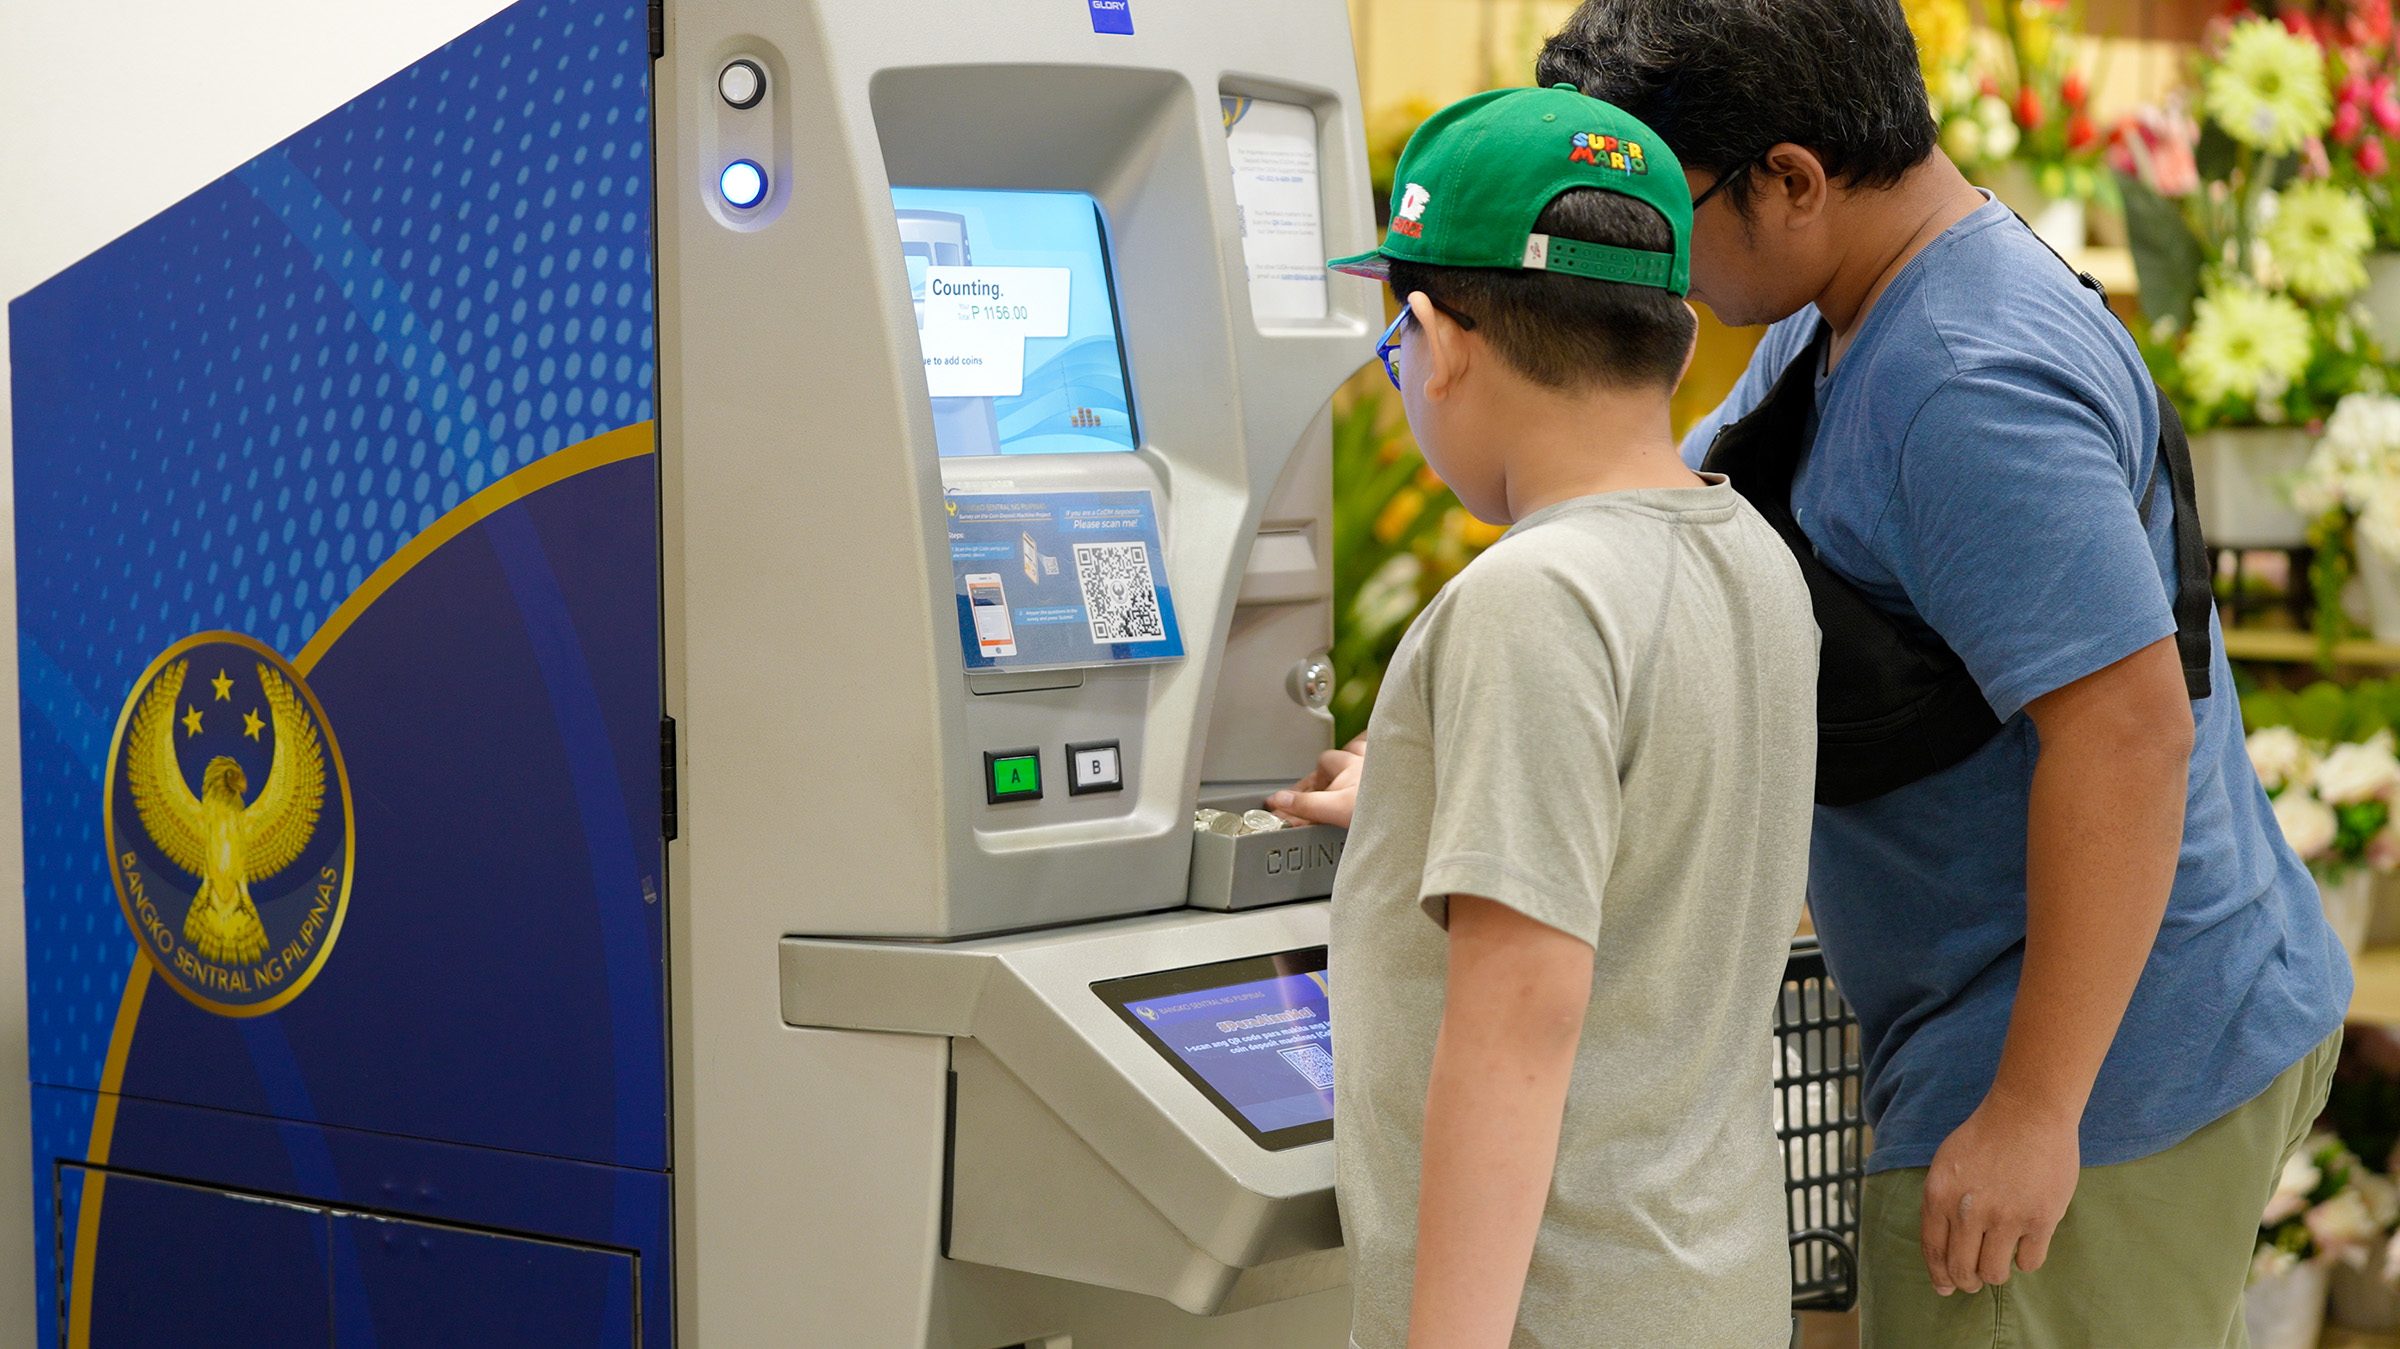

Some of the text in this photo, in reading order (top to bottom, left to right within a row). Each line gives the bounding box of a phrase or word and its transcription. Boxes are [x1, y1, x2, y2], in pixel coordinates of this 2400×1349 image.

[1093, 0, 1126, 10] GLORY
[1571, 131, 1644, 160] SUPER
[1568, 146, 1647, 174] MARIO
[932, 278, 1004, 301] Counting.
[971, 305, 1028, 320] P 1156.00
[934, 356, 942, 365] to
[944, 356, 960, 365] add
[961, 355, 983, 366] coins
[1073, 519, 1100, 529] Please
[1101, 519, 1120, 528] scan
[1012, 768, 1021, 784] A
[1092, 760, 1101, 775] B
[1267, 842, 1344, 875] COIN
[120, 850, 338, 993] BANGKO SENTRAL NG PILIPINAS
[1211, 1039, 1230, 1048] ang
[1227, 1037, 1242, 1046] QR
[1241, 1033, 1263, 1042] code
[1262, 1030, 1281, 1040] para
[1280, 1025, 1310, 1035] makita
[1308, 1022, 1327, 1031] ang
[1230, 1045, 1249, 1054] coin
[1248, 1040, 1279, 1050] deposit
[1278, 1033, 1317, 1045] machines
